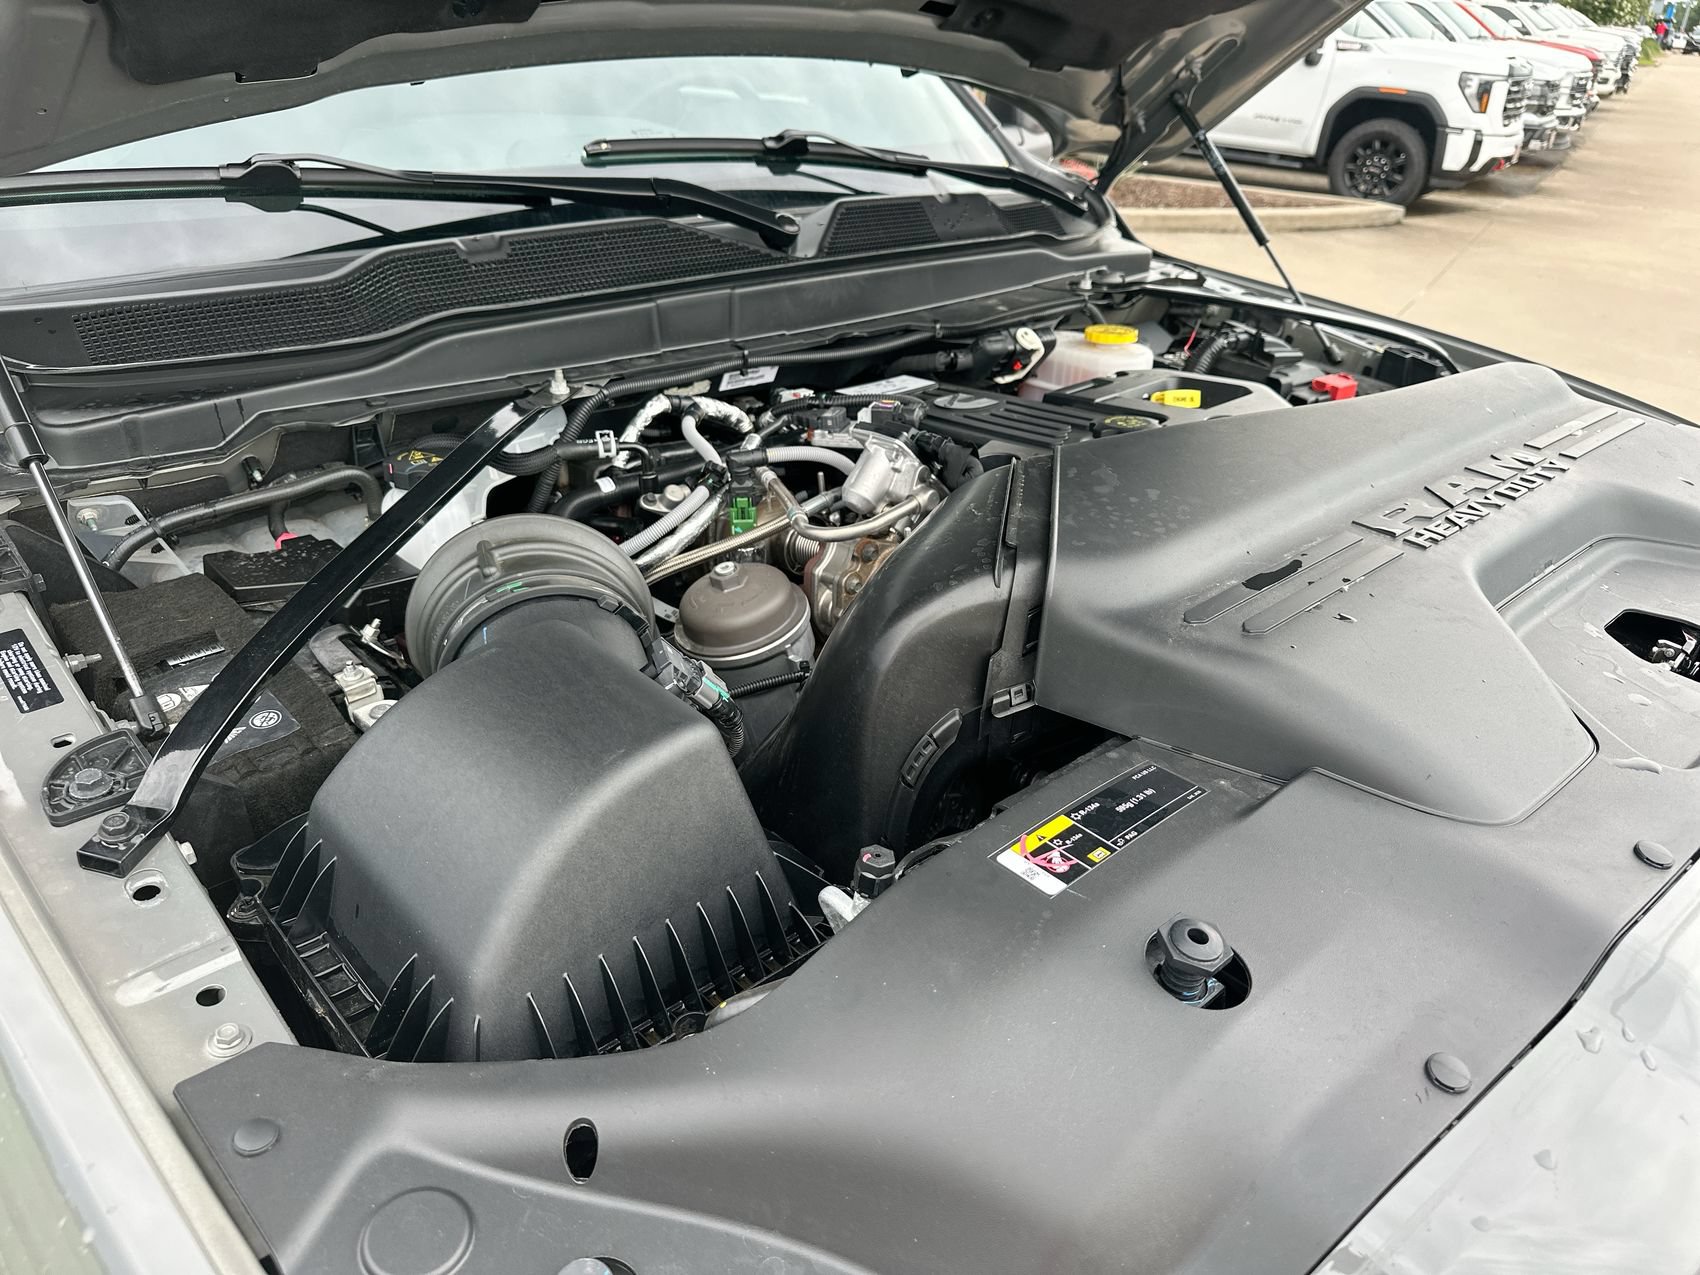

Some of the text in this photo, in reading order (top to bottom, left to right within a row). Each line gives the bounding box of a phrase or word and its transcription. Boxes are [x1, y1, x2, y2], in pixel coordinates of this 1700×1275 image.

[1352, 451, 1548, 537] RAM
[1403, 459, 1570, 549] HEAVY DUTY
[1078, 801, 1100, 815] R-134a
[1123, 830, 1138, 839] PAG
